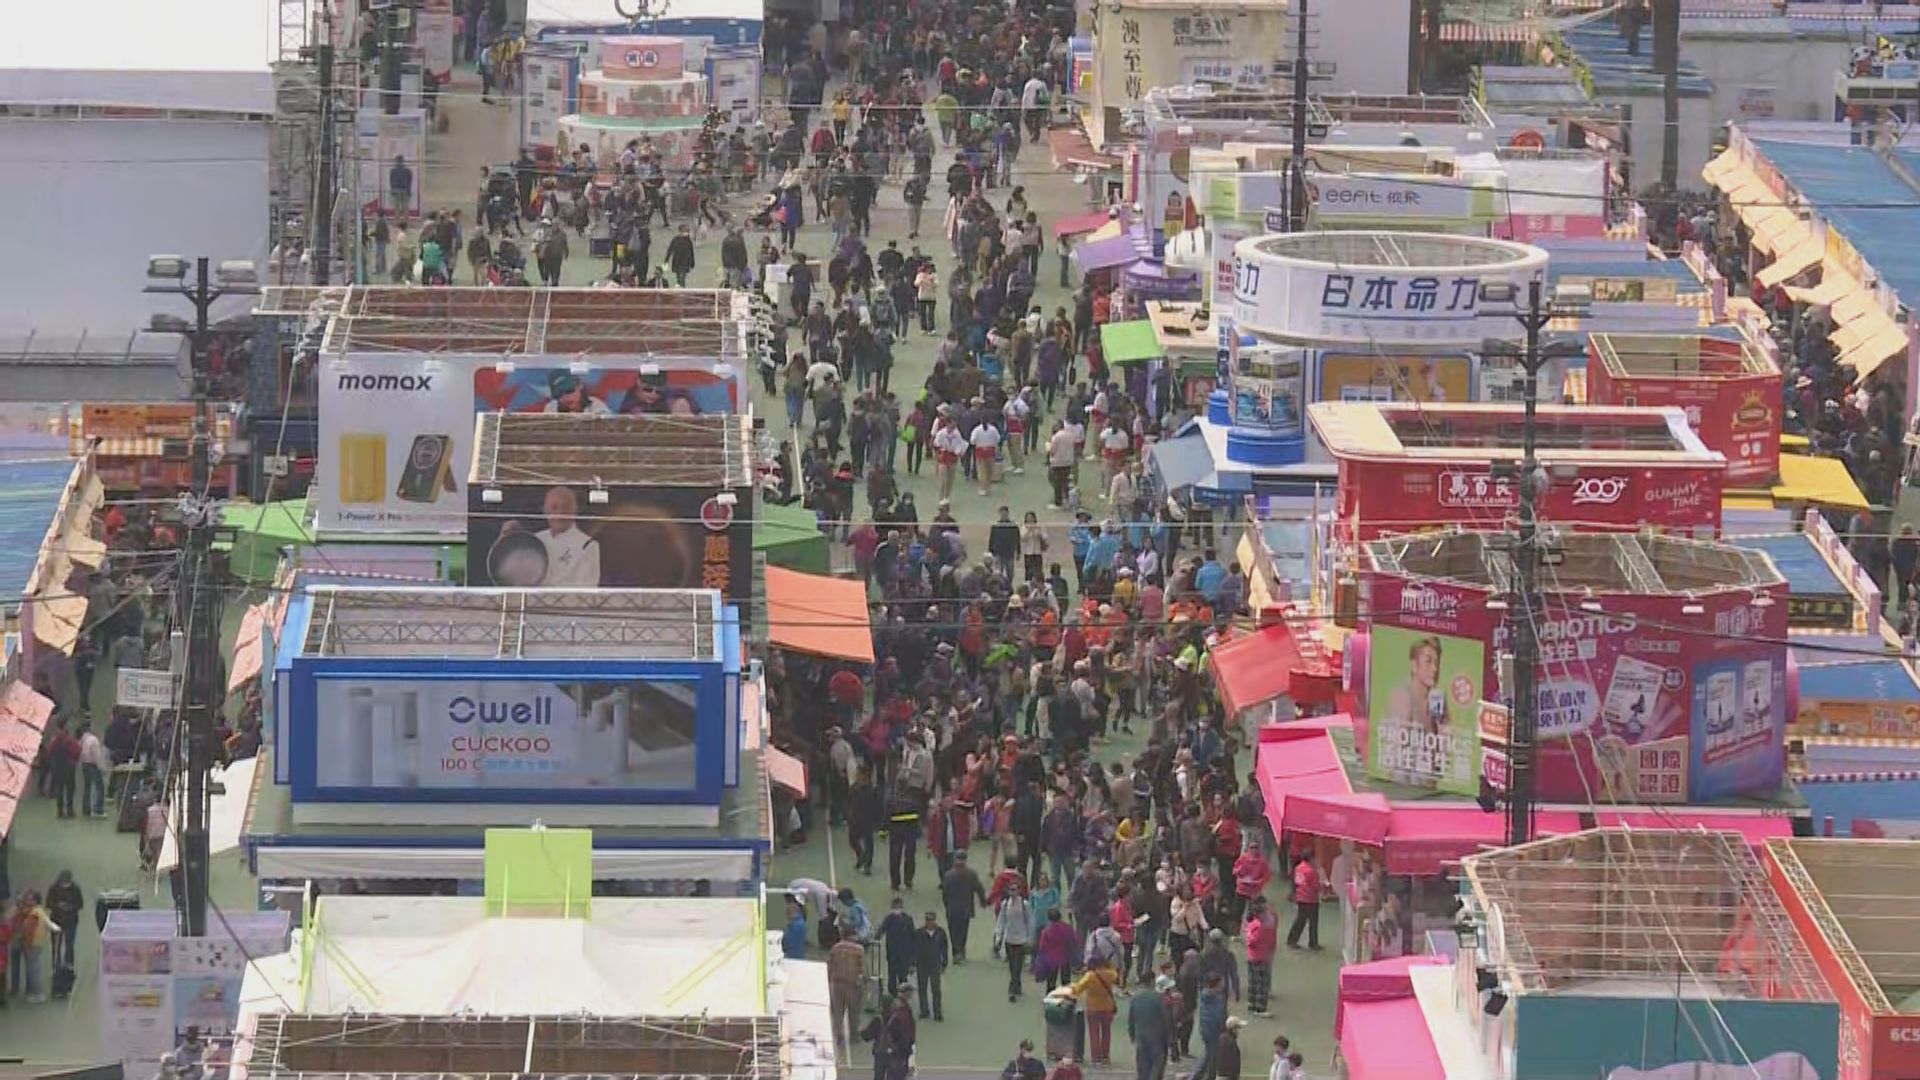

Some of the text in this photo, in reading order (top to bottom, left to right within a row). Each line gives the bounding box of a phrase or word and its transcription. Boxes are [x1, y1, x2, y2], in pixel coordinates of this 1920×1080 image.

[1121, 18, 1143, 100] 澳至尊
[1321, 274, 1480, 312] 日本命力
[338, 375, 433, 390] momax
[1645, 481, 1699, 502] GUMMY
[1672, 495, 1701, 508] TIME
[1493, 612, 1637, 648] PBIOTICS
[452, 736, 551, 752] CUCKOO
[441, 758, 468, 770] 100
